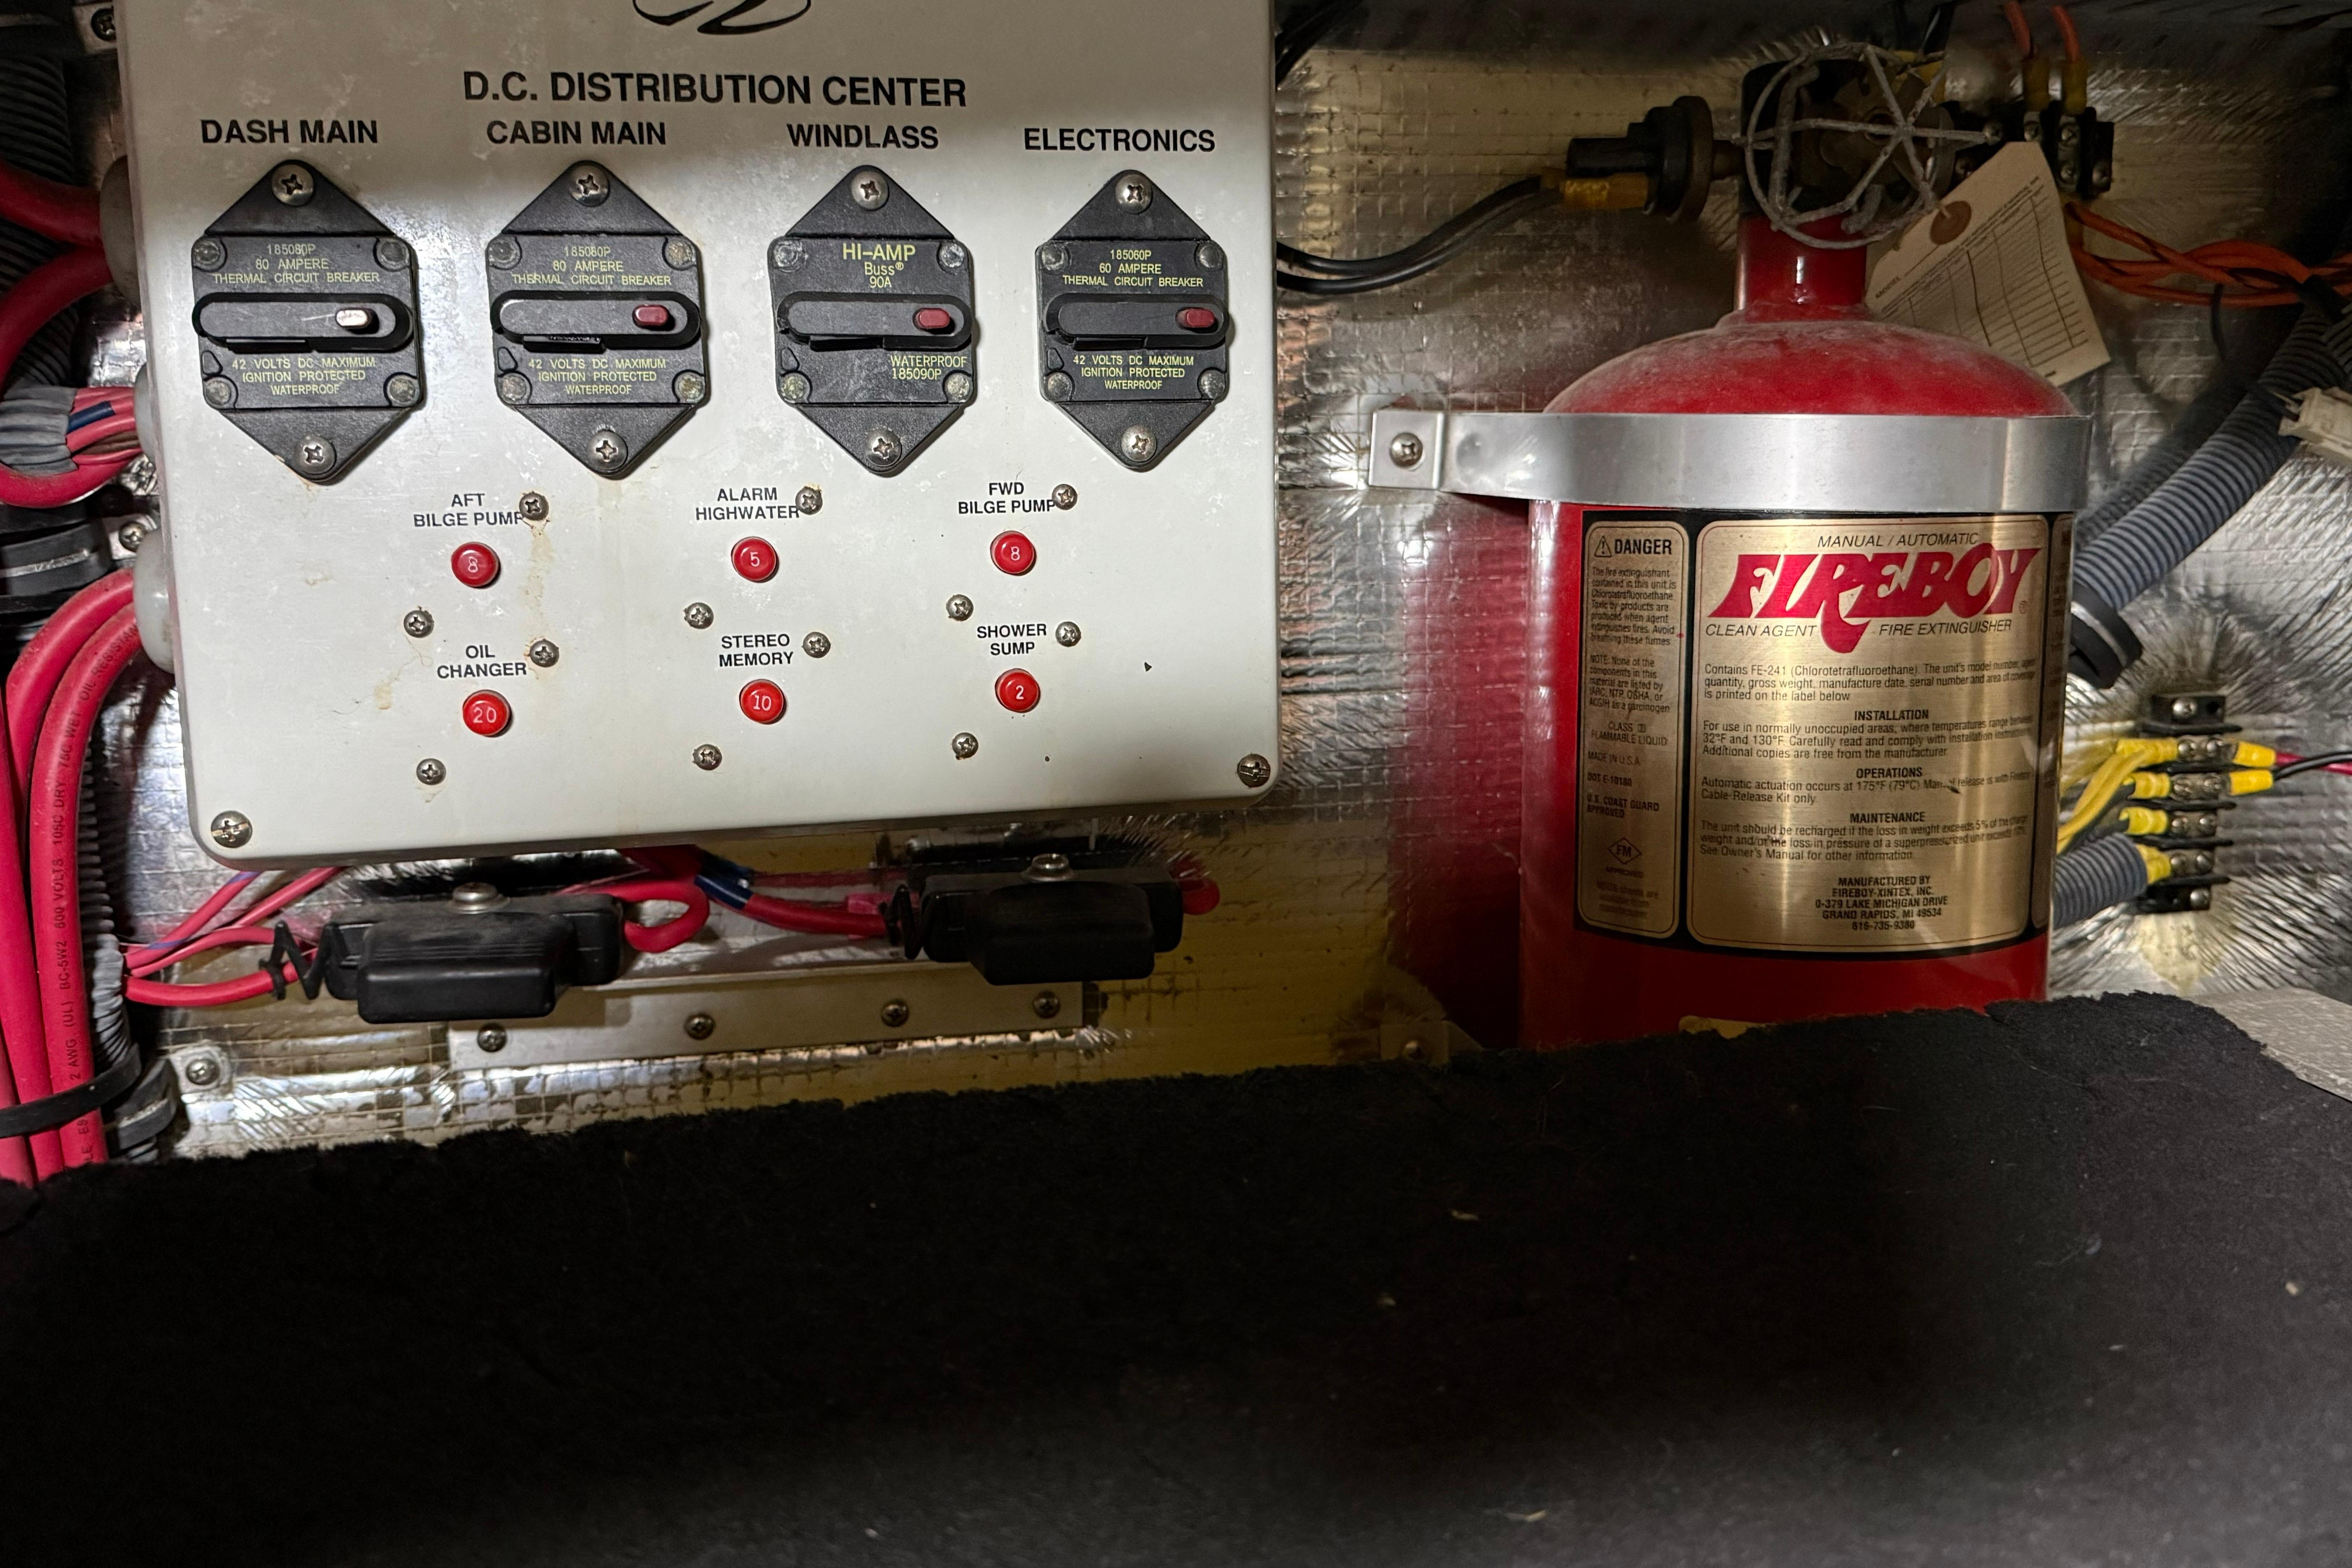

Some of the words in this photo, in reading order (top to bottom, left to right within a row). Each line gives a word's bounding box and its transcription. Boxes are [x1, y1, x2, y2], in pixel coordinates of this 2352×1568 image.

[464, 70, 537, 101] D.C.
[551, 72, 810, 105] DISTRIBUTION
[823, 76, 966, 107] CENTER
[201, 119, 288, 143] DASH
[300, 120, 377, 143] MAIN
[488, 121, 581, 144] CABIN
[592, 121, 665, 145] MAIN
[786, 124, 939, 149] WINDLASS
[1024, 128, 1215, 152] ELECTRONICS
[267, 244, 316, 255] 185080P
[564, 247, 610, 257] 185080P
[843, 243, 915, 261] HI-AMP
[1110, 250, 1151, 260] 185060P
[256, 259, 269, 270] 80
[278, 259, 329, 270] AMPERE
[553, 261, 566, 271] 80
[575, 261, 624, 271] AMPERE
[1099, 263, 1111, 273] 60
[1118, 264, 1161, 274] AMPERE
[215, 273, 266, 284] THERMAL
[274, 273, 319, 283] CIRCUIT
[327, 273, 379, 282] BREAKER
[512, 274, 563, 284] THERMAL
[572, 275, 614, 285] CIRCUIT
[622, 276, 671, 285] BREAKER
[870, 276, 892, 288] 90A
[1063, 275, 1108, 286] THERMAL
[1114, 277, 1153, 287] CIRCUIT
[1159, 278, 1203, 287] BREAKER
[232, 359, 247, 369] 42
[254, 358, 290, 369] VOLTS
[298, 357, 313, 368] DC
[321, 357, 375, 368] MAXIMUM
[529, 359, 542, 369] 42
[550, 359, 585, 369] VOLTS
[593, 359, 608, 369] DC
[616, 358, 666, 369] MAXIMUM
[891, 355, 967, 367] WATERPROOF
[1073, 355, 1085, 364] 42
[1092, 355, 1122, 365] VOLTS
[1129, 355, 1143, 365] DC
[1149, 355, 1193, 366] MAXIMUM
[243, 372, 291, 383] IGNITION
[300, 370, 365, 381] PROTECTED
[539, 372, 586, 382] IGNITION
[594, 371, 656, 381] PROTECTED
[892, 368, 941, 380] 185090P
[1082, 367, 1122, 377] IGNITION
[1129, 368, 1185, 378] PROTECTED
[271, 384, 339, 395] WATERPROOF
[565, 385, 632, 394] WATERPROOF
[1104, 380, 1162, 390] WATERPROOF
[717, 487, 777, 501] ALARM
[989, 482, 1024, 495] FWD
[451, 493, 485, 507] AFT
[959, 501, 1006, 514] BILGE
[1012, 499, 1055, 513] PUMP
[696, 506, 799, 520] HIGHWATER
[413, 513, 468, 527] BILGE
[1615, 539, 1672, 555] DANGER
[1818, 535, 1884, 548] MANUAL
[1896, 533, 1978, 546] AUTOMATIC
[750, 552, 760, 567] 5
[1010, 546, 1020, 561] 8
[467, 557, 478, 573] 8
[977, 623, 1046, 638] SHOWER
[1706, 624, 1757, 637] CLEAN
[1760, 625, 1817, 637] AGENT
[1879, 623, 1912, 636] FIRE
[1918, 619, 2012, 635] EXTINGUISHER
[721, 634, 790, 649] STEREO
[466, 645, 495, 658] OIL
[991, 642, 1034, 656] SUMP
[719, 651, 793, 667] MEMORY
[437, 663, 527, 679] CHANGER
[1705, 664, 1748, 675] Contains
[1751, 665, 1786, 675] FE-241
[1924, 663, 1940, 673] The
[1968, 661, 1990, 671] model
[1748, 679, 1776, 689] gross
[1819, 677, 1881, 688] manufacture
[1910, 677, 1934, 687] serial
[1937, 676, 1968, 686] number
[1016, 685, 1024, 700] 2
[1716, 690, 1751, 700] printed
[1772, 691, 1787, 700] the
[1792, 691, 1816, 701] label
[1820, 691, 1850, 701] below
[753, 695, 771, 711] 10
[474, 707, 497, 723] 20
[1855, 709, 1929, 721] INSTALLATION
[64, 710, 81, 738] WET
[1703, 720, 1720, 730] For
[1722, 722, 1739, 732] use
[1743, 723, 1751, 732] in
[1756, 723, 1801, 735] normally
[1805, 723, 1864, 736] unoccupied
[1901, 723, 1929, 732] where
[1932, 720, 1986, 732] temperatures
[1730, 735, 1748, 745] and
[1790, 736, 1835, 748] Carefully
[1840, 737, 1862, 746] read
[1866, 736, 1884, 746] and
[1888, 735, 1923, 747] comply
[1927, 733, 1946, 744] with
[1949, 730, 1993, 743] installation
[1856, 767, 1923, 778] OPERATIONS
[54, 782, 66, 809] DRY
[1850, 812, 1925, 823] MAINTENANCE
[1616, 845, 1631, 857] FM
[51, 857, 65, 901] VOLTS
[1838, 876, 1916, 886] MANUFACTURED
[1919, 875, 1930, 884] BY
[1846, 899, 1870, 908] LAKE
[1874, 898, 1919, 908] MICHIGAN
[1923, 896, 1948, 906] DRIVE
[1822, 910, 1857, 919] GRAND
[1860, 910, 1899, 919] RAPIDS,
[1902, 909, 1913, 918] MI
[65, 1038, 81, 1068] AWG
